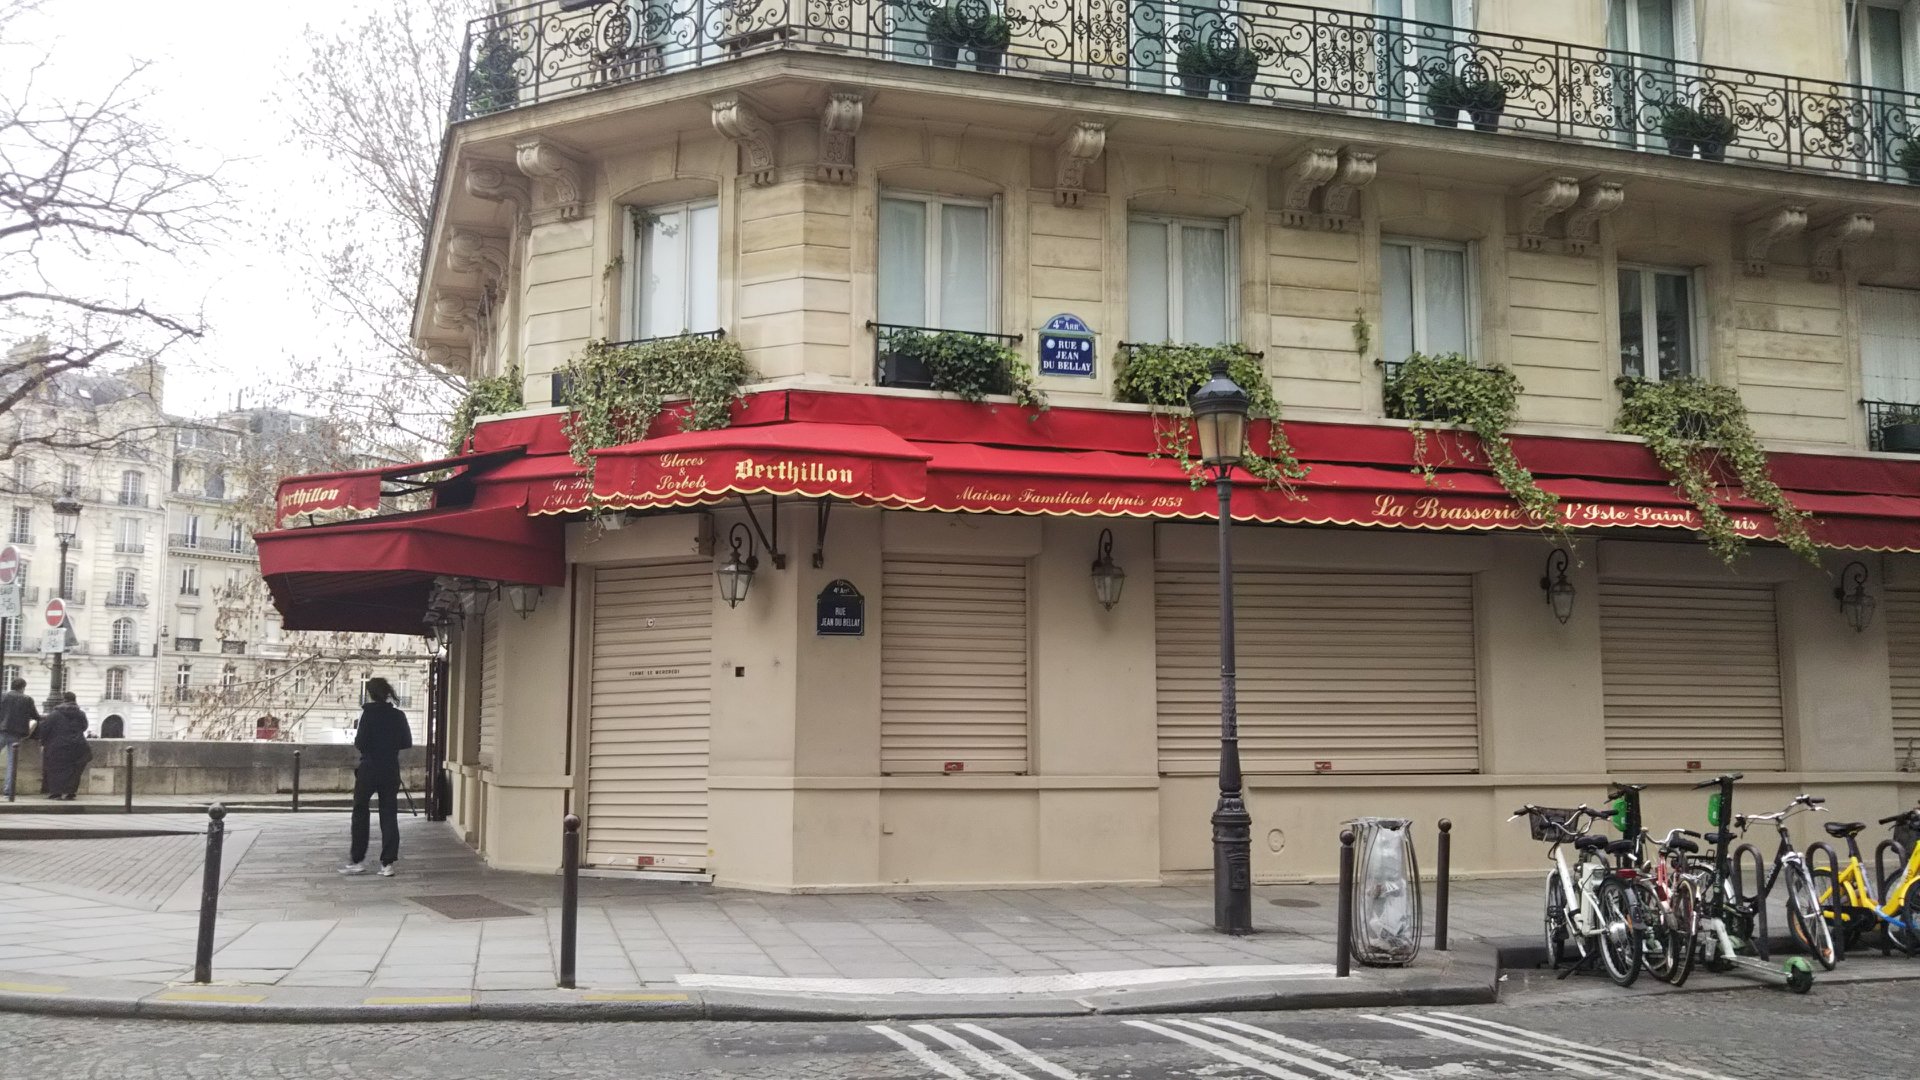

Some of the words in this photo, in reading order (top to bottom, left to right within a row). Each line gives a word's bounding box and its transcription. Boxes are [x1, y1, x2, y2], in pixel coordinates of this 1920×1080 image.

[1058, 340, 1077, 350] RUE
[1055, 351, 1079, 361] JEAN
[1043, 360, 1055, 369] DU
[1057, 361, 1092, 372] BELLAY
[659, 453, 707, 468] Glaces
[678, 468, 687, 476] &
[735, 458, 853, 485] Berthillon
[956, 486, 1012, 501] Maison
[1018, 488, 1093, 505] Familiale
[1098, 492, 1145, 511] depuis
[1151, 495, 1183, 507] 1953
[1371, 494, 1408, 517] La
[1412, 496, 1524, 519] Brasserie
[1565, 503, 1629, 520] l'Isle
[835, 607, 846, 615] RUE
[821, 618, 834, 626] JEAN
[834, 618, 842, 626] DU
[842, 618, 860, 626] BELLAY
